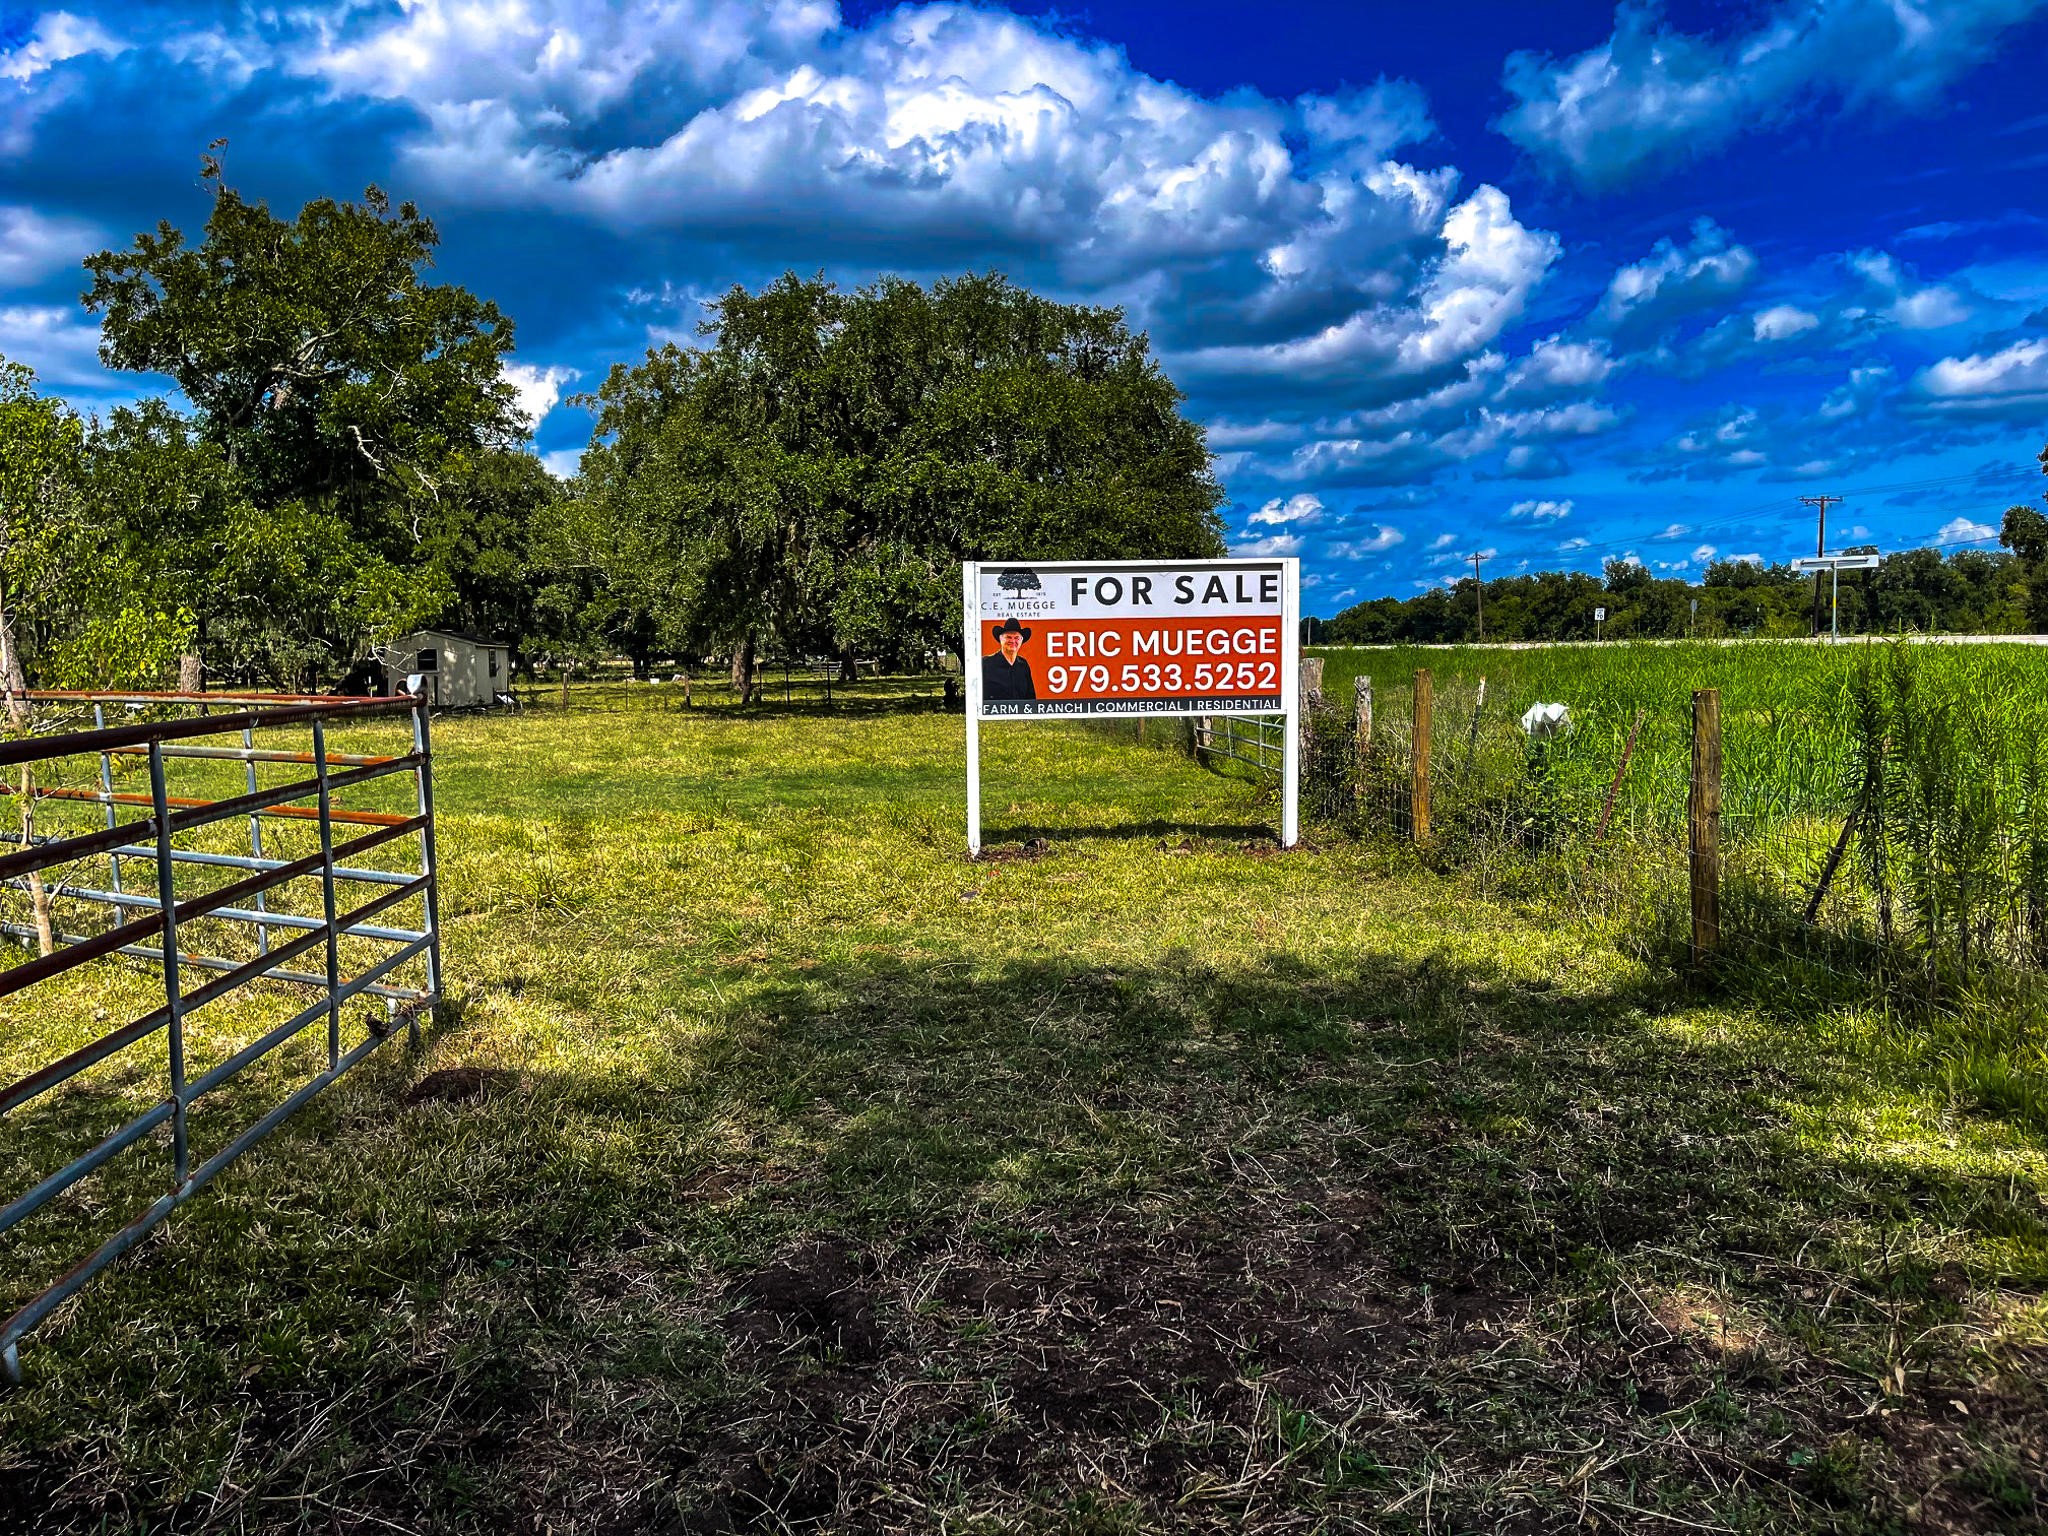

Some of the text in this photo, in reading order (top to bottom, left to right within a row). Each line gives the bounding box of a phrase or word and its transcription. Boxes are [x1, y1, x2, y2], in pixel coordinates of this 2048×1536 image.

[1071, 575, 1278, 605] FOR SALE
[981, 601, 1056, 610] C.E. MUEGGE
[1047, 628, 1277, 657] ERIC MUEGGE
[1047, 662, 1277, 694] 979.533.5252
[983, 704, 1018, 714] FARM
[1023, 704, 1033, 714] &
[1038, 703, 1082, 713] RANCH
[1096, 701, 1183, 712] COMMERCIAL
[1197, 699, 1279, 710] RESIDENTIAL
